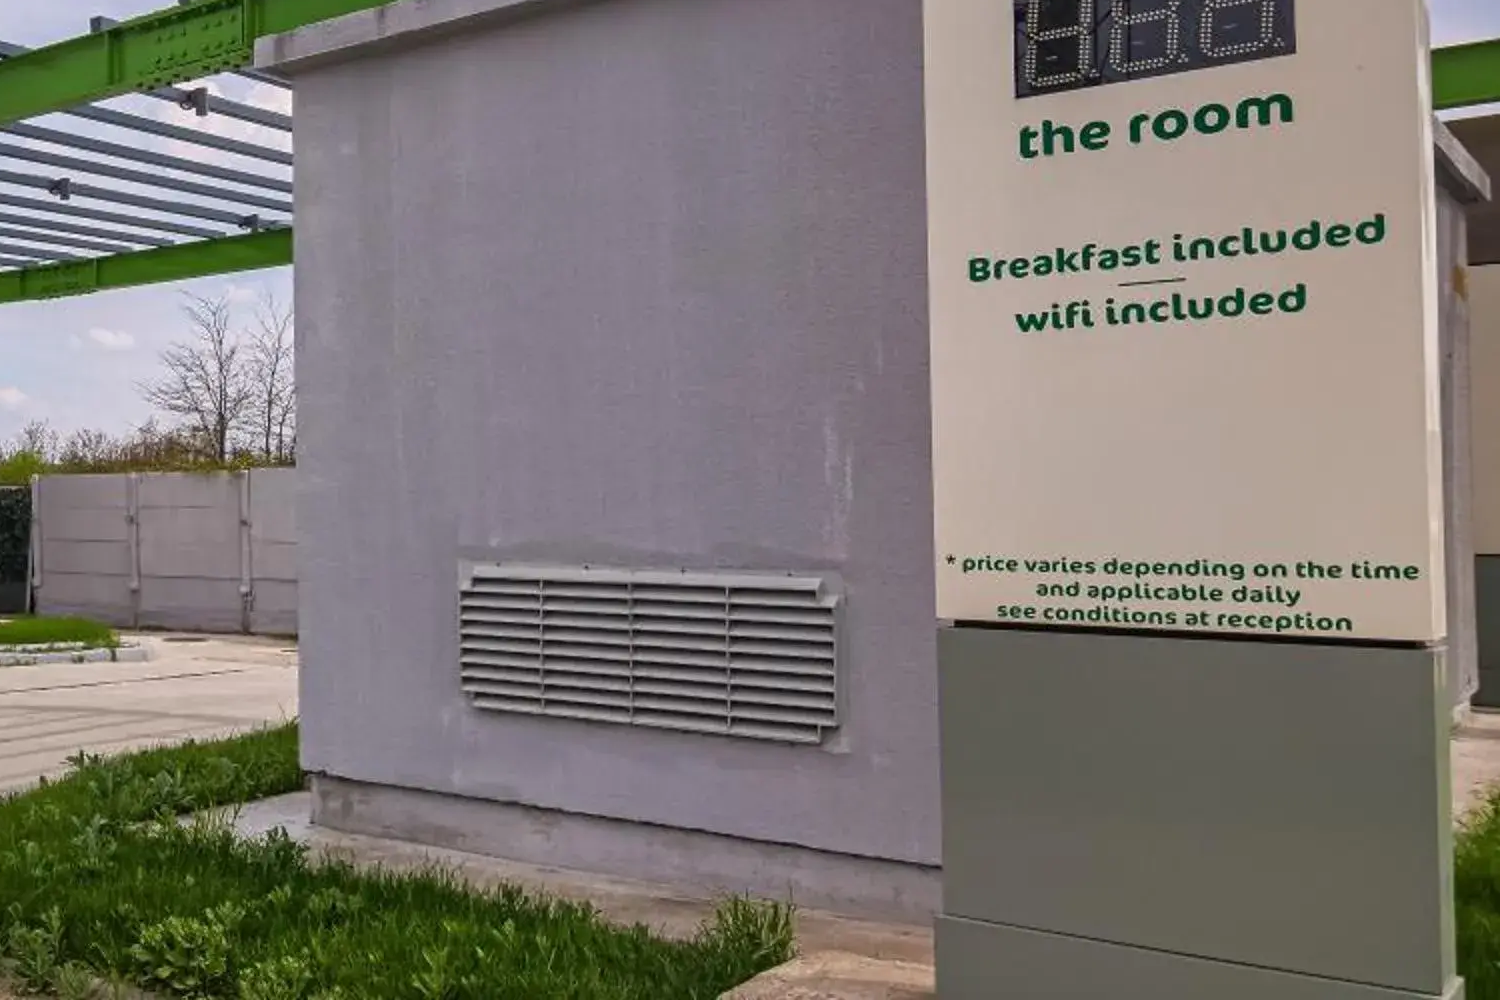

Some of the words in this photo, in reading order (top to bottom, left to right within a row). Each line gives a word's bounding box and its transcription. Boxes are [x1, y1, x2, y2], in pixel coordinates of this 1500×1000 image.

[1019, 119, 1111, 159] the
[1128, 93, 1295, 145] room
[968, 239, 1161, 283] Breakfast
[1173, 213, 1386, 263] included
[1014, 300, 1095, 333] wifi
[1106, 283, 1307, 326] included
[962, 556, 1019, 574] price
[1023, 557, 1097, 575] varies
[1102, 558, 1246, 581] depending
[1253, 564, 1288, 578] on
[1295, 561, 1343, 579] the
[1351, 561, 1420, 581] time
[1035, 581, 1081, 598] and
[1086, 583, 1224, 603] applicable
[1231, 585, 1301, 608] daily
[997, 604, 1037, 620] see
[1043, 605, 1177, 626] conditions
[1184, 611, 1211, 627] at
[1217, 613, 1353, 633] reception
